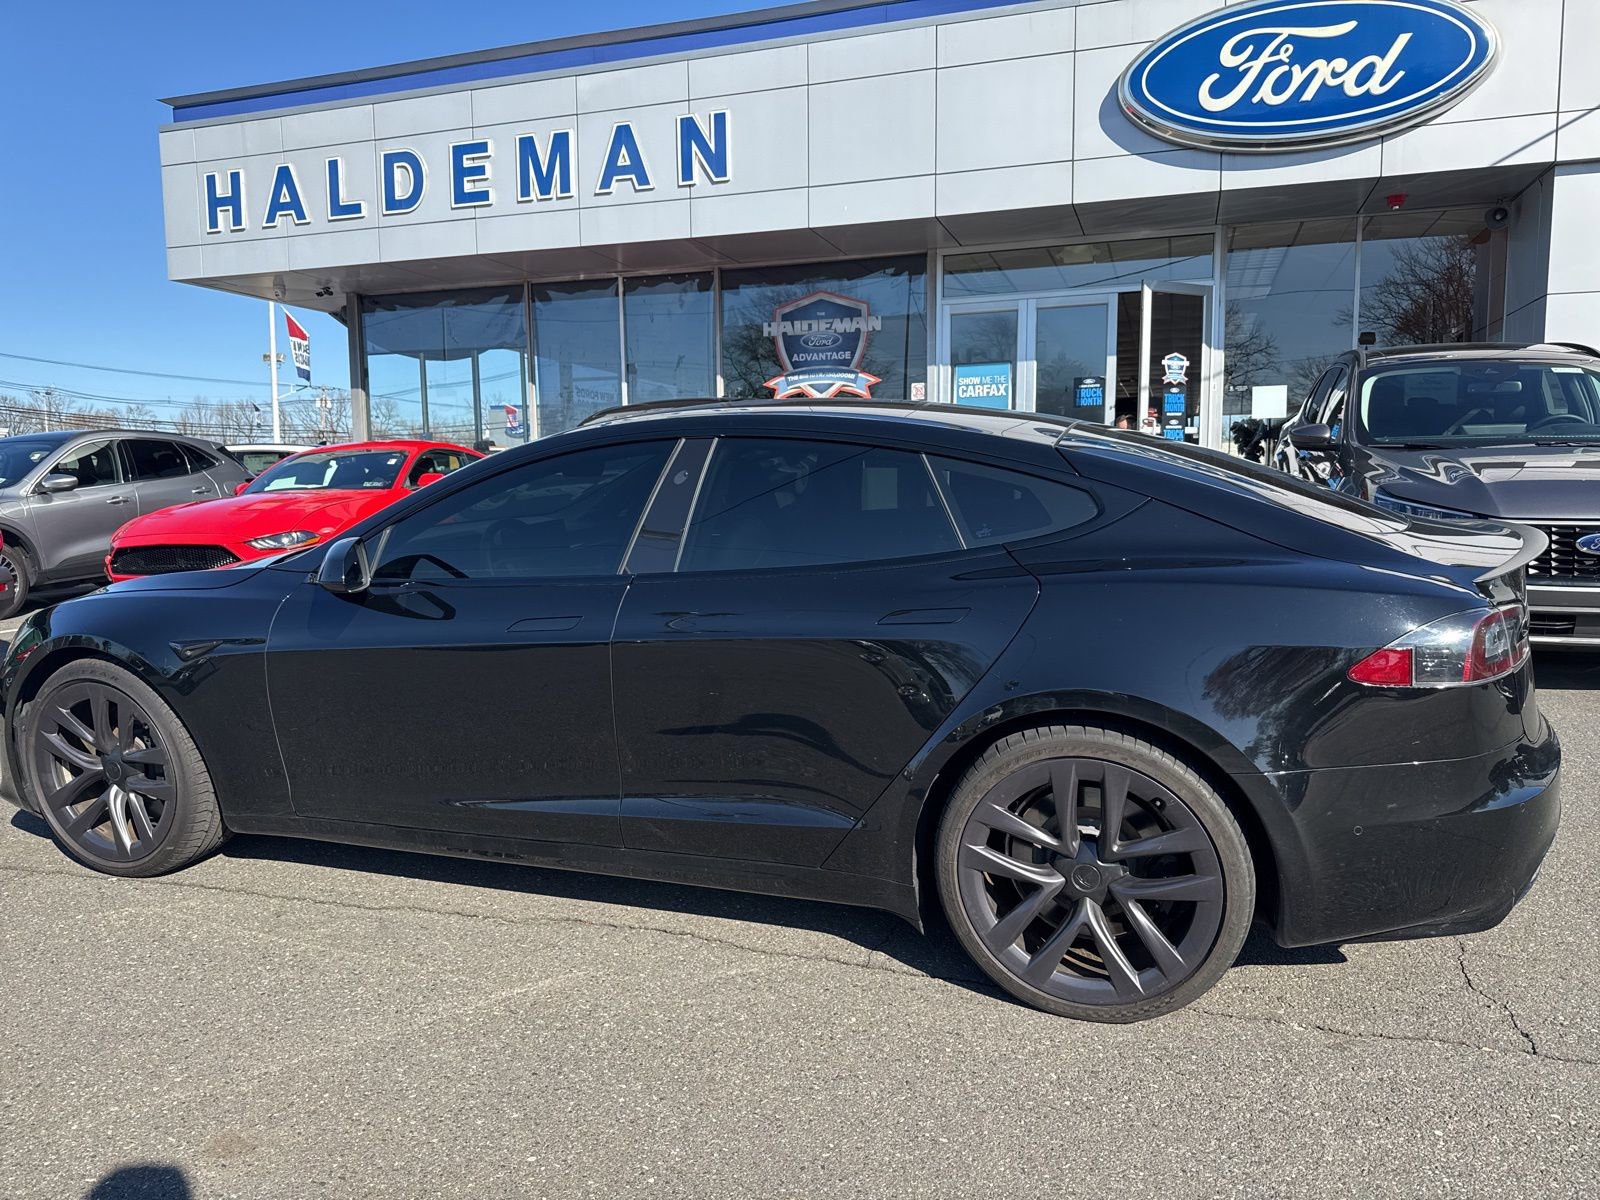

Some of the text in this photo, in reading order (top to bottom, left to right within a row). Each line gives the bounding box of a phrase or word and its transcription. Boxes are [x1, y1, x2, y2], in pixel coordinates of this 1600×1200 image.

[1198, 20, 1413, 112] Ford
[203, 108, 732, 233] HALDEMAN
[808, 334, 834, 346] Ford
[792, 351, 851, 362] ADVANTAGE
[958, 374, 1007, 385] SHOW ME THE
[958, 383, 1008, 398] CARFAX
[1075, 387, 1103, 398] TRUCK
[1164, 393, 1185, 403] TRUCK
